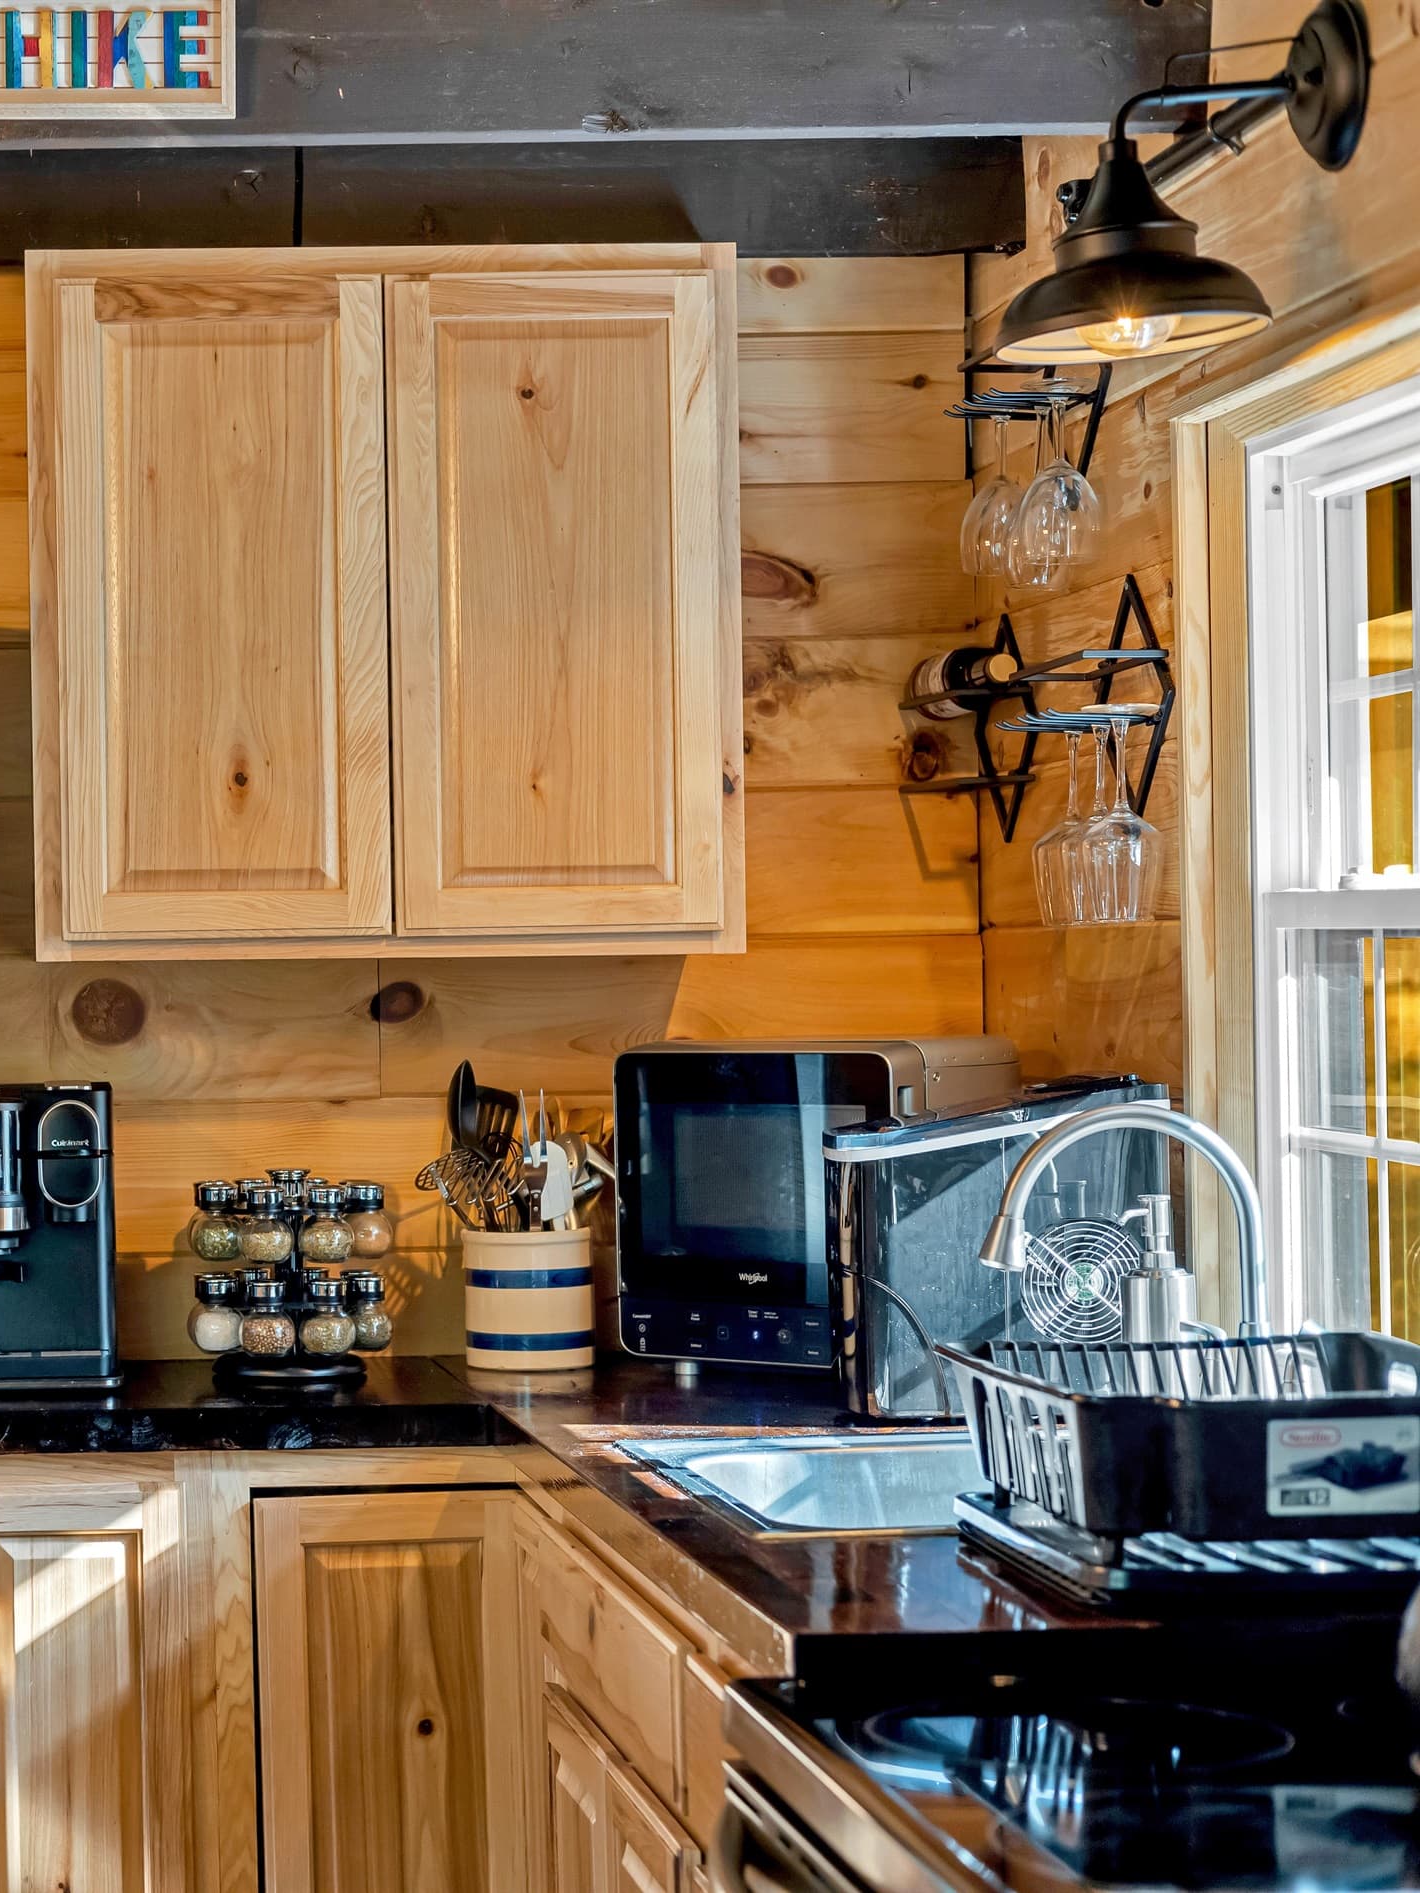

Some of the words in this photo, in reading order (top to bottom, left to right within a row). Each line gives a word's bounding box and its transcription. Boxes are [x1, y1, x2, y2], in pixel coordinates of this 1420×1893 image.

[4, 9, 211, 90] HIKE
[52, 1139, 89, 1147] Cuisinart
[738, 1272, 768, 1284] Whirlpool
